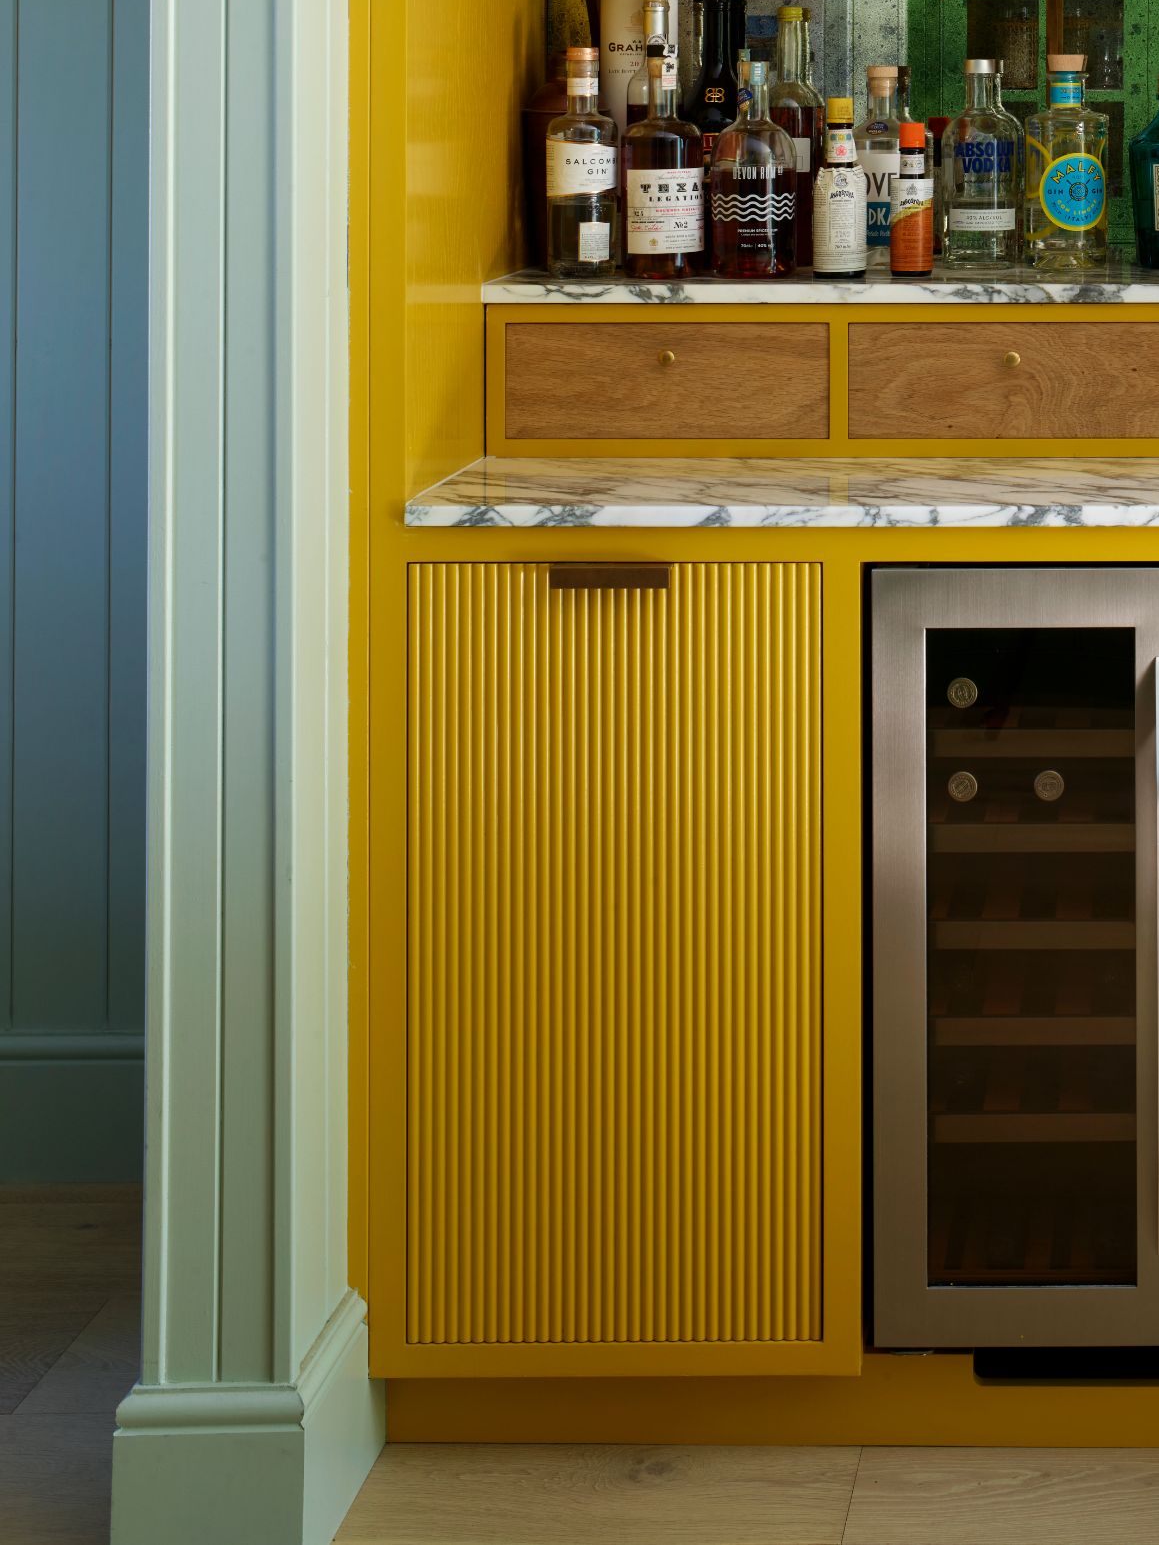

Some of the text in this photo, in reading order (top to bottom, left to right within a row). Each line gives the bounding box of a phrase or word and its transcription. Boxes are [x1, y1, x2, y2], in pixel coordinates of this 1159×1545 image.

[608, 42, 643, 52] GRAH
[953, 141, 1015, 157] ABSOUT
[732, 166, 757, 180] DEVON
[760, 166, 776, 180] RUM
[1052, 161, 1101, 184] MALFY
[640, 182, 702, 194] TEXA
